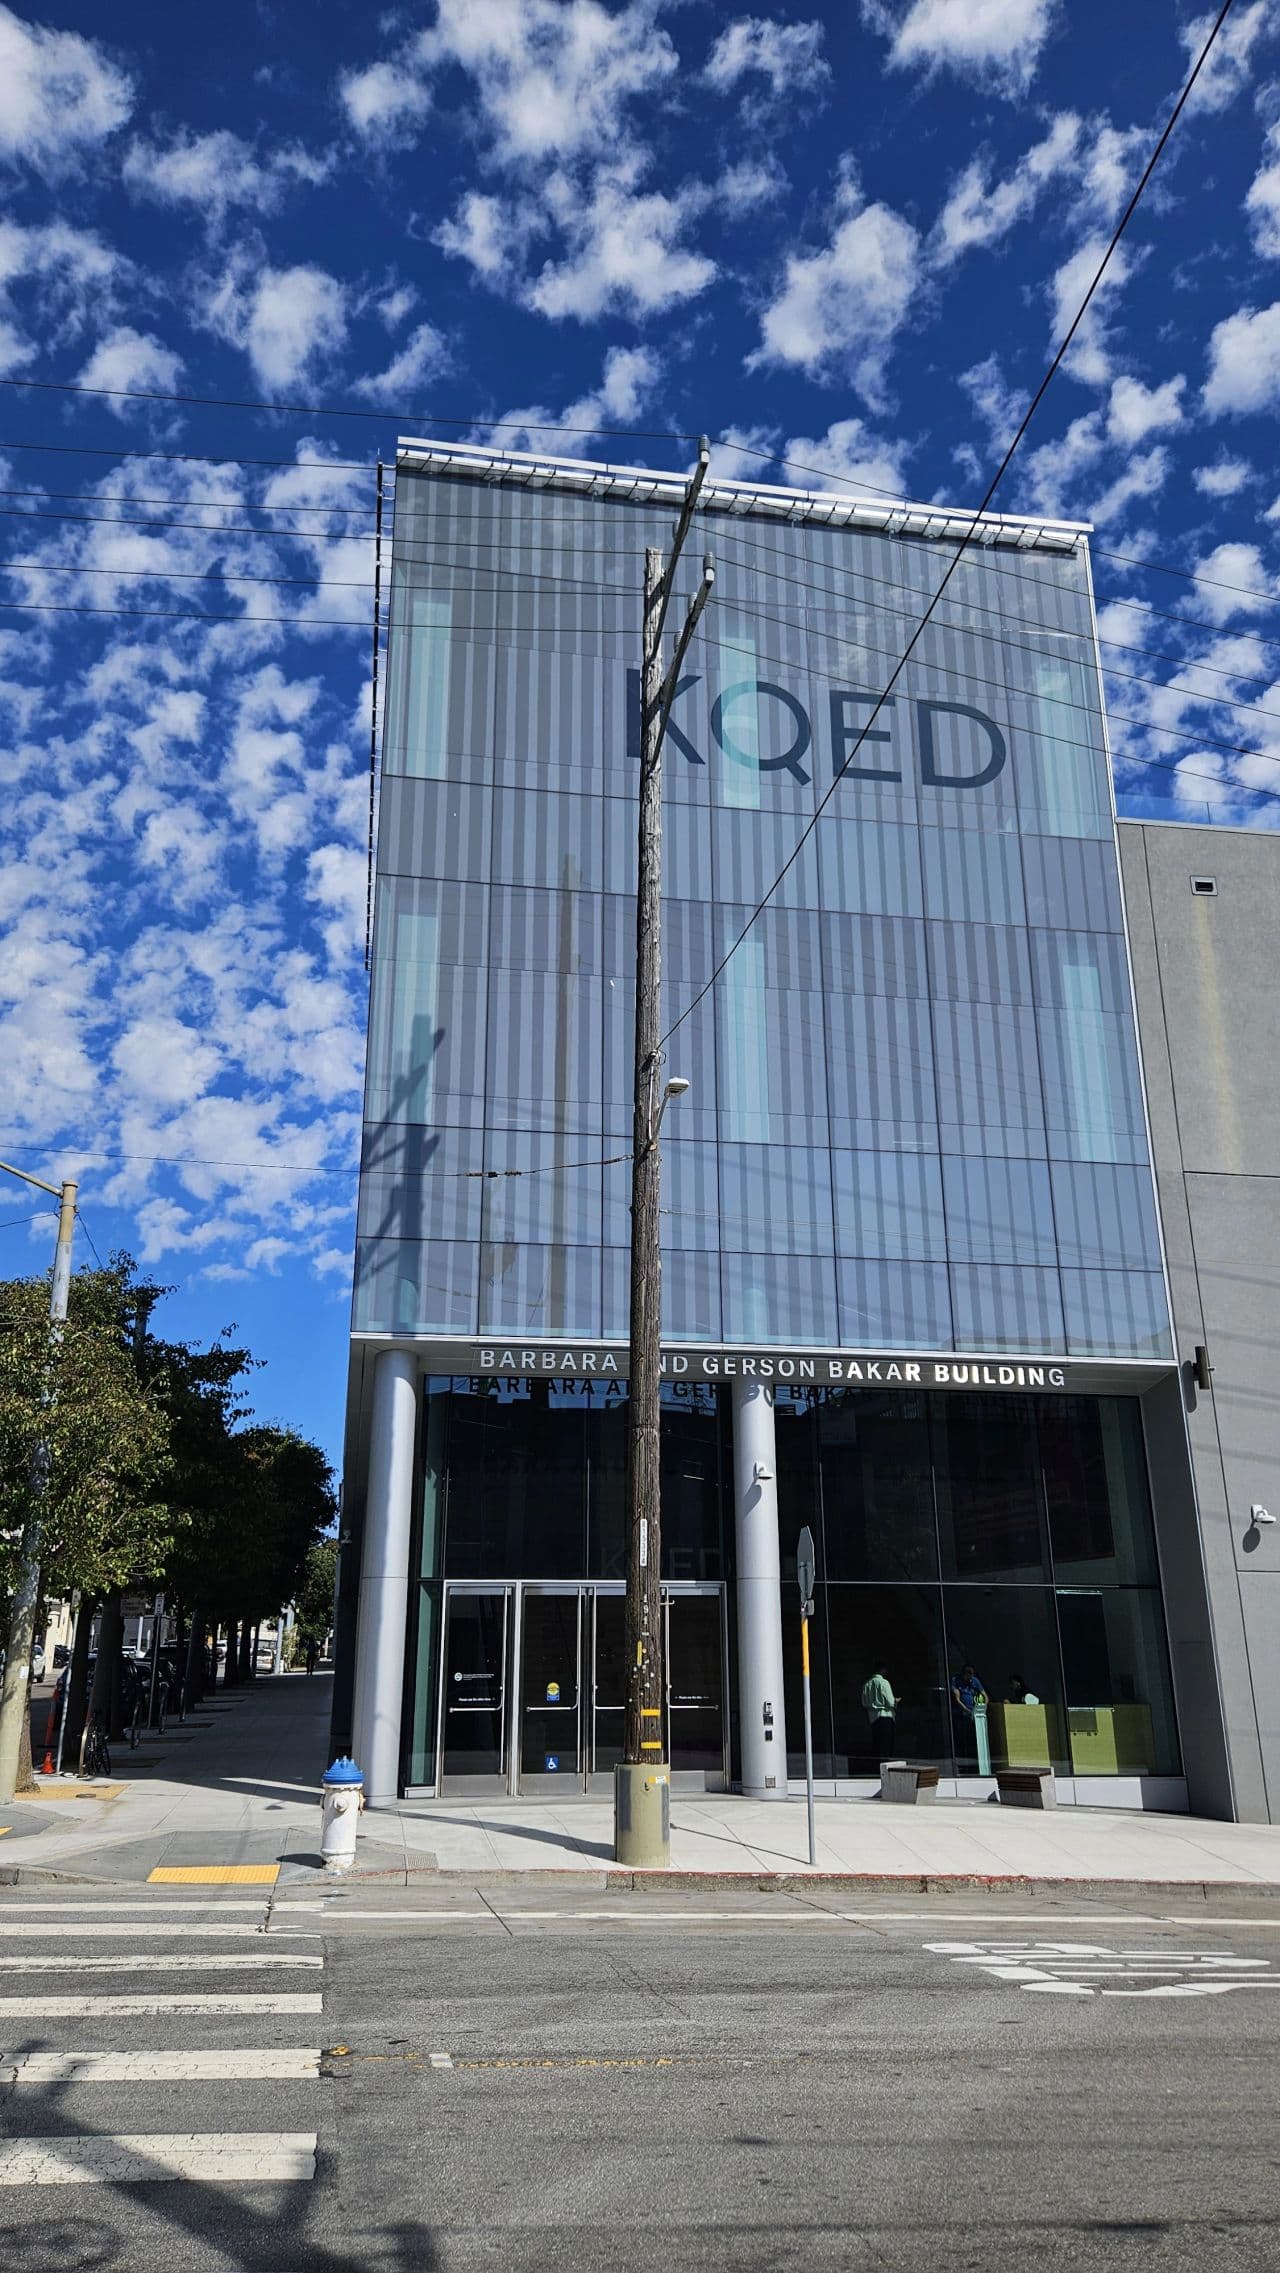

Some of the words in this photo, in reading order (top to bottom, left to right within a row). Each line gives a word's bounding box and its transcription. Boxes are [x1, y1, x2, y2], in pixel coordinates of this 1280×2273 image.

[626, 668, 1007, 789] KQED
[480, 1350, 618, 1371] BARBARA
[659, 1355, 688, 1373] ND
[702, 1356, 815, 1378] GERSON
[828, 1361, 921, 1381] BAKAR
[935, 1364, 1065, 1387] BUILDING
